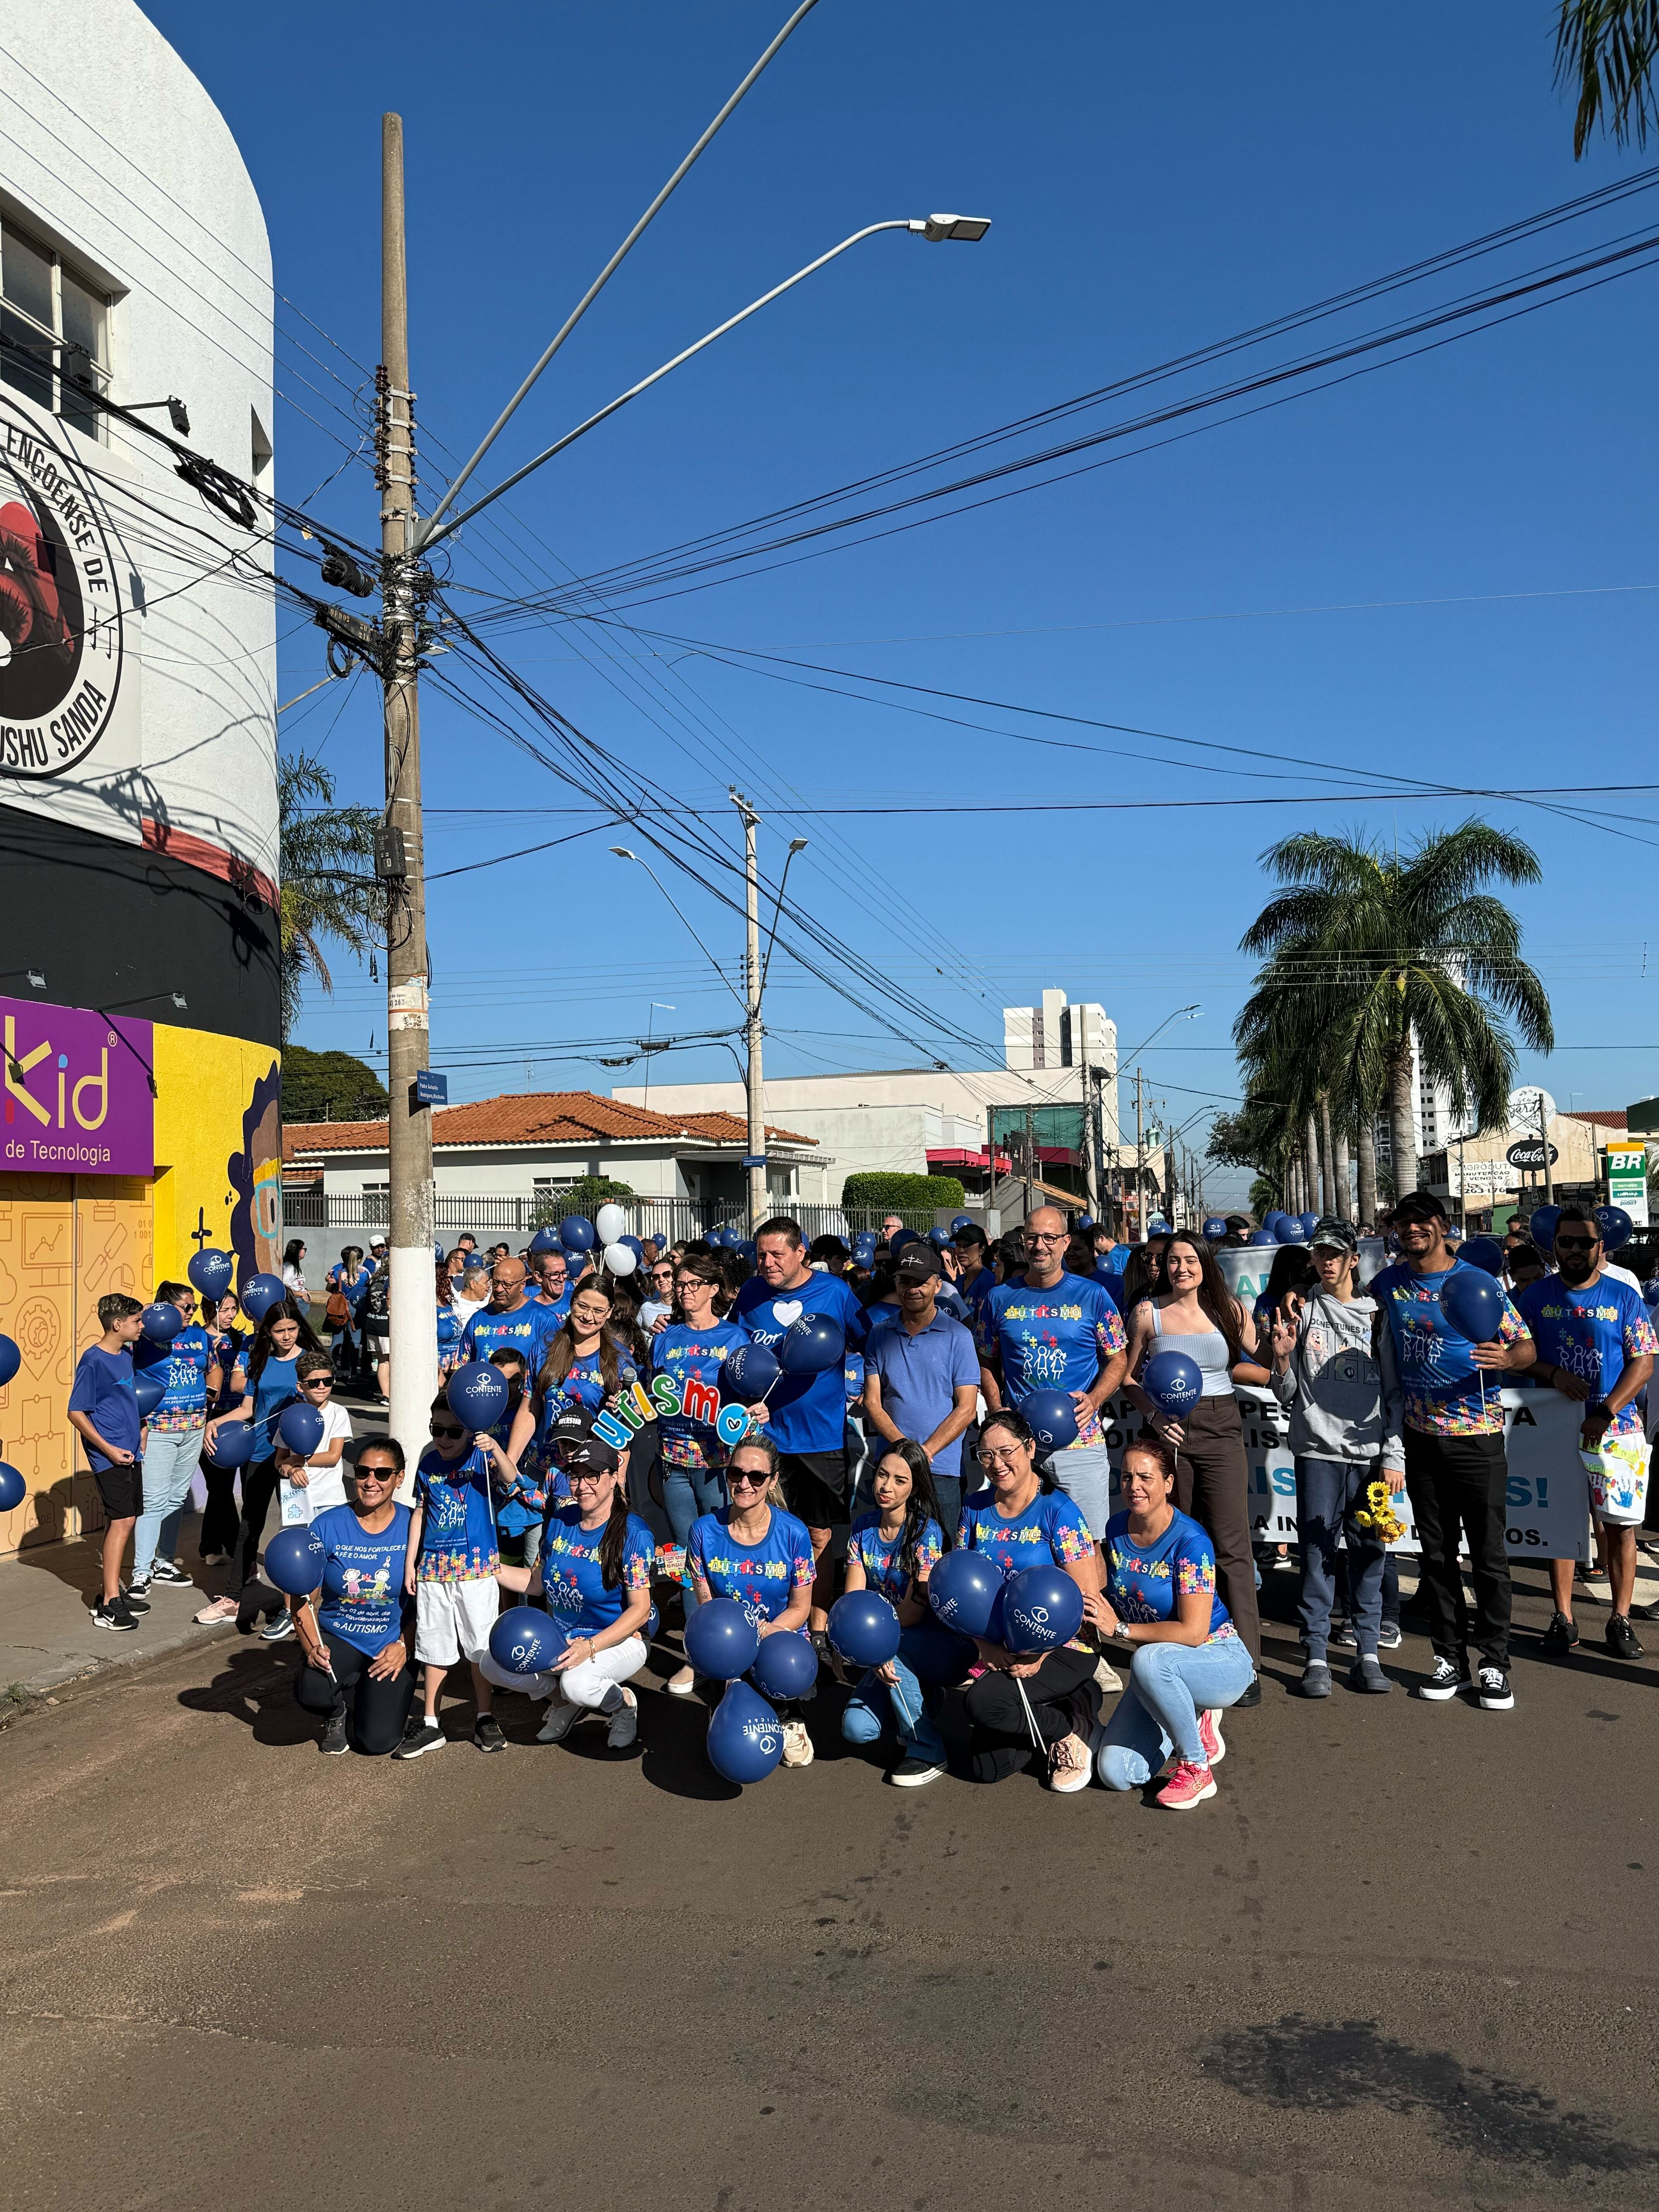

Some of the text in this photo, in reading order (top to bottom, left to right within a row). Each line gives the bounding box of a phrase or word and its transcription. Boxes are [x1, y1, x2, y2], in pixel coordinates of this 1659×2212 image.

[1, 425, 109, 593] ENÇOENSE DE
[50, 679, 107, 758] SANDA
[6, 1139, 110, 1166] de Tecnologia
[1611, 1155, 1642, 1170] BR
[1007, 1306, 1081, 1318] AUTISMO
[1543, 1308, 1617, 1319] AUTISMO
[475, 1325, 531, 1336] AUTISMO
[1335, 1322, 1360, 1334] TUNES
[667, 1346, 728, 1359] AUTISMO
[466, 1386, 502, 1394] CONTENTE
[1161, 1388, 1197, 1399] CONTENTE
[29, 1513, 52, 1527] CODE
[1505, 1527, 1548, 1546] OS.
[709, 1559, 787, 1577] AUTISMO
[340, 1622, 388, 1633] AUTISMO
[1014, 1609, 1057, 1639] CONTENTE
[515, 1638, 540, 1672] CONTENTE
